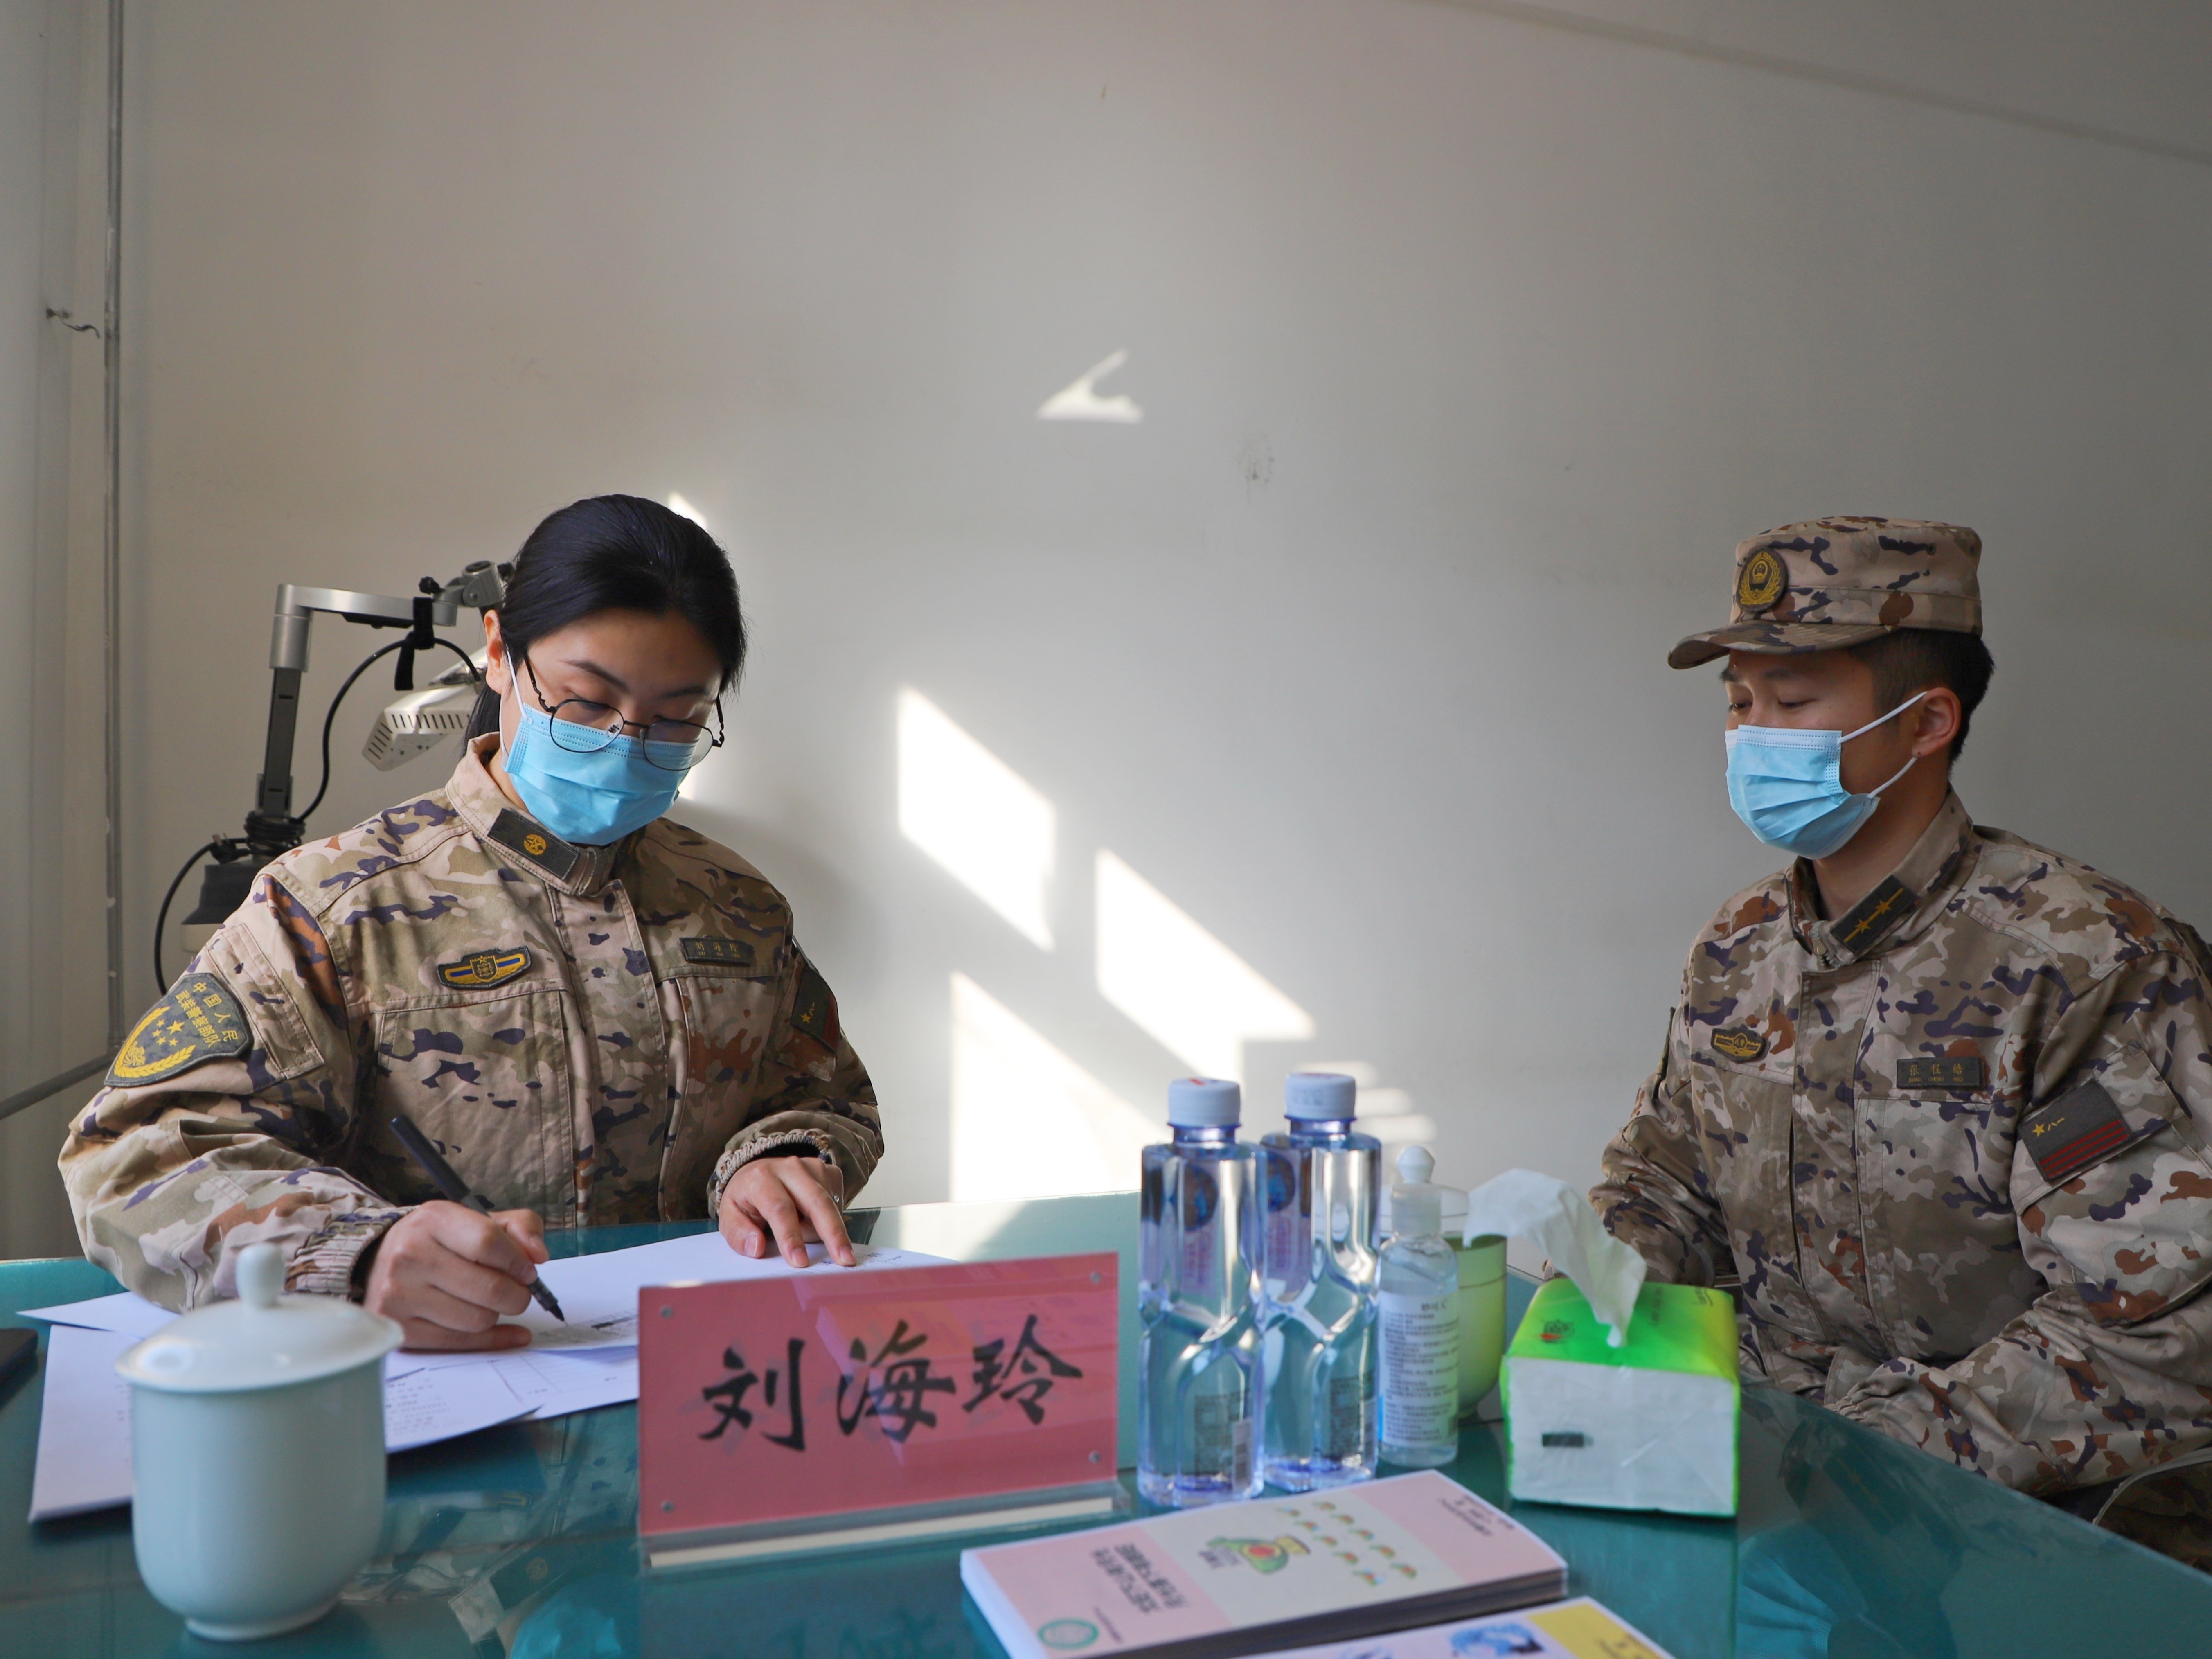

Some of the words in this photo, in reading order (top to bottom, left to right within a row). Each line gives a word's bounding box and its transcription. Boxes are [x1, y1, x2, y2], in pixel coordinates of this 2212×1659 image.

[175, 990, 221, 1048] 武装警察部队
[193, 982, 239, 1042] 中国人民
[2047, 1117, 2065, 1131] 八一
[698, 1314, 1084, 1452] 刘海玲
